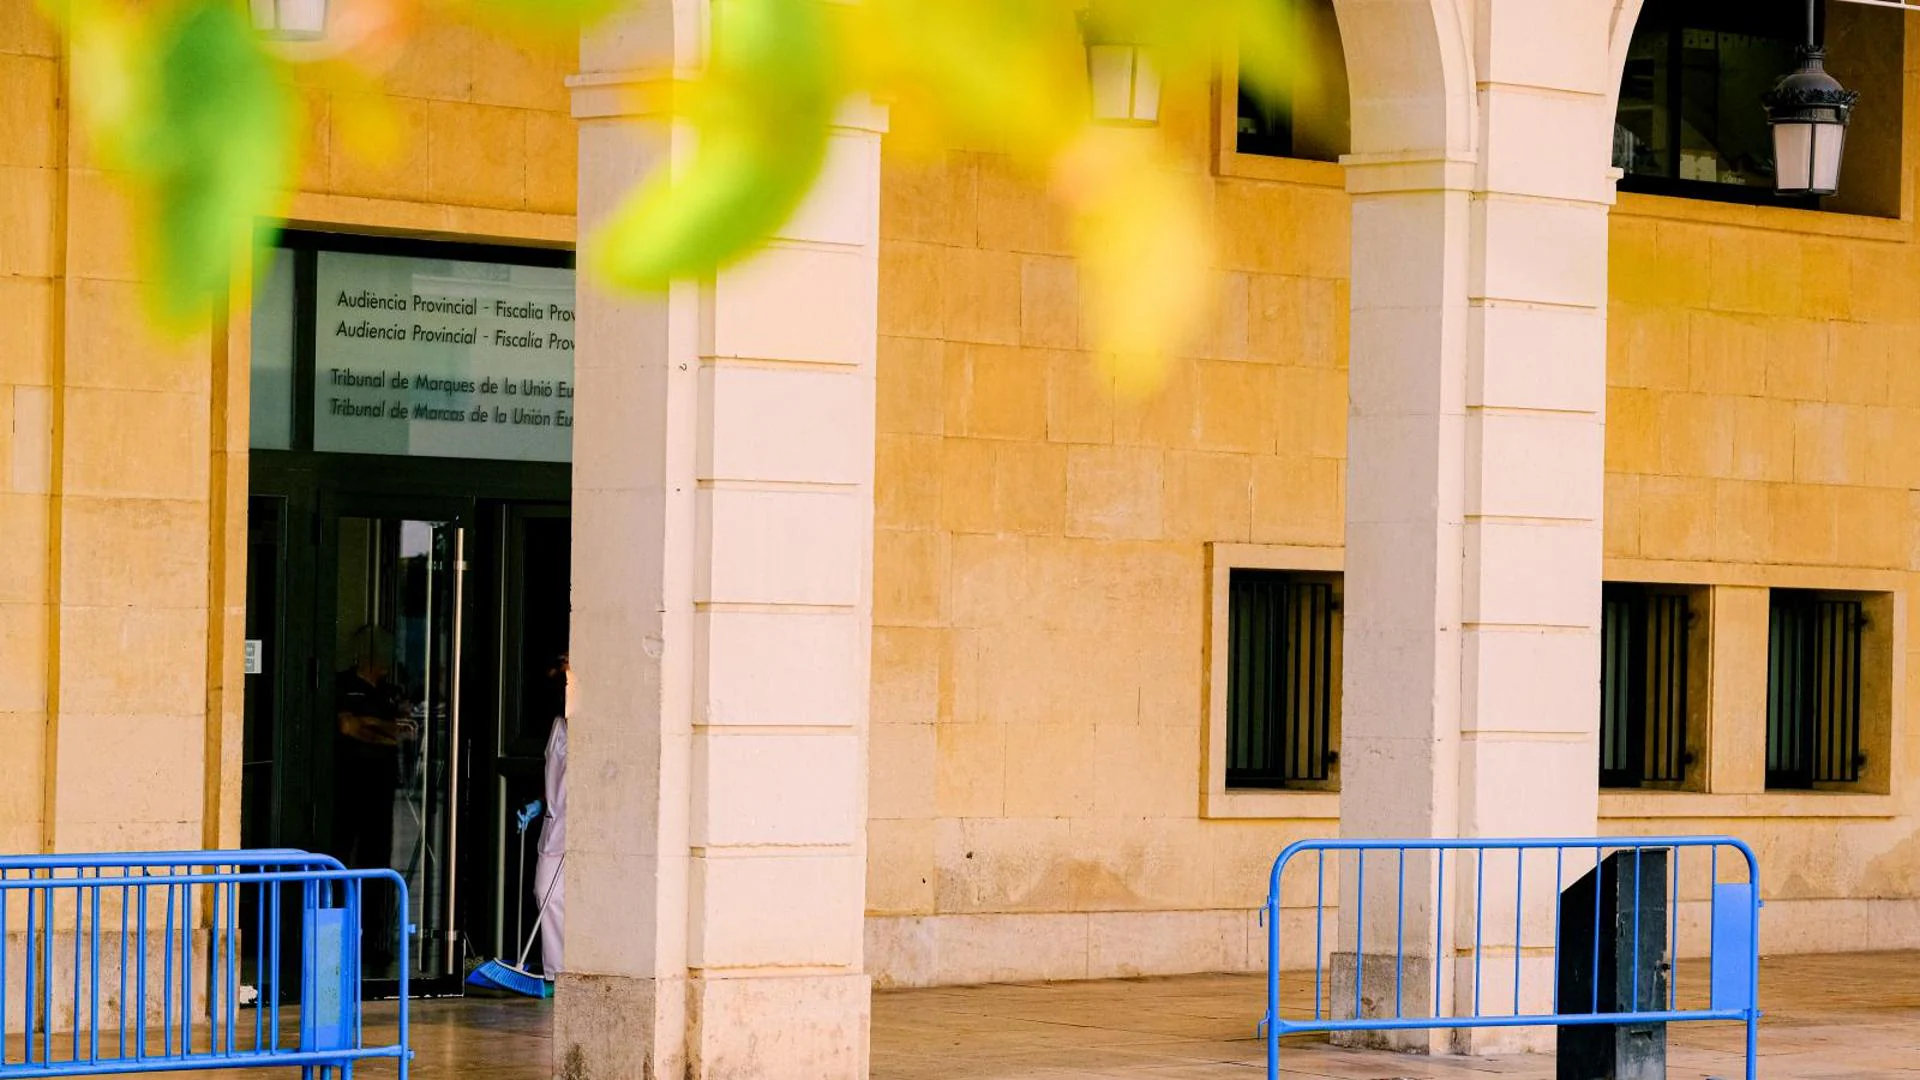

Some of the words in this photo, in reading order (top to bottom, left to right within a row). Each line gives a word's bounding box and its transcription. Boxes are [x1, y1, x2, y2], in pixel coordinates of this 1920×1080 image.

[337, 290, 407, 311] Audiència
[413, 294, 477, 315] Provincial
[496, 300, 543, 319] Fiscalia
[336, 320, 406, 340] Audiencia
[412, 324, 477, 344] Provincial
[495, 330, 543, 349] Fiscalía
[331, 368, 385, 387] Tribunal
[391, 371, 409, 389] de
[415, 373, 475, 396] Marques
[480, 376, 498, 394] de
[505, 377, 517, 395] la
[523, 379, 552, 397] Unió
[330, 398, 386, 418] Tribunal
[390, 400, 408, 419] de
[414, 402, 465, 422] Marcas
[471, 405, 488, 423] de
[495, 406, 507, 423] la
[513, 407, 551, 426] Unión
